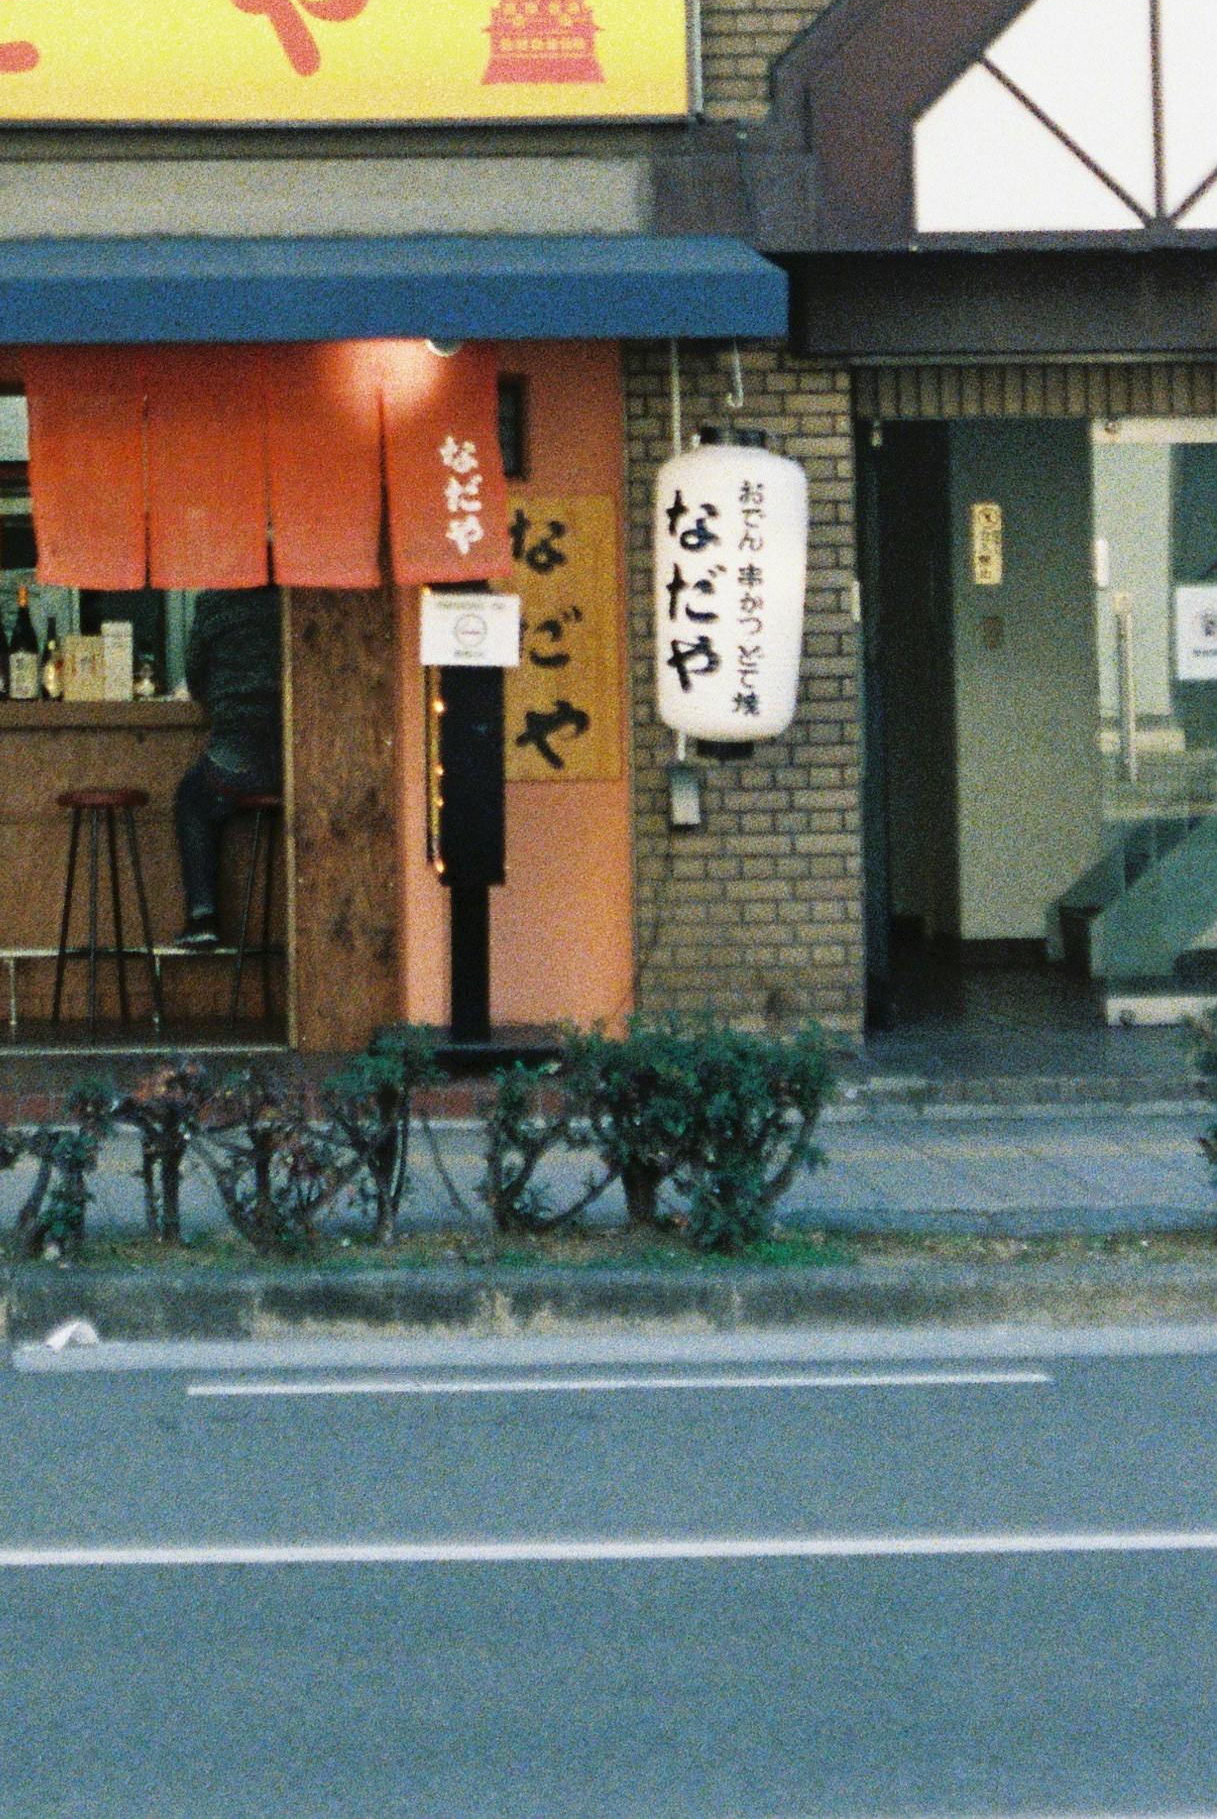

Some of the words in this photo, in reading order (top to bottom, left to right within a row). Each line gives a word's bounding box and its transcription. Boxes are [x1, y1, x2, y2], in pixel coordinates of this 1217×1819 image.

[438, 434, 484, 556] なだや
[666, 489, 727, 693] なだや
